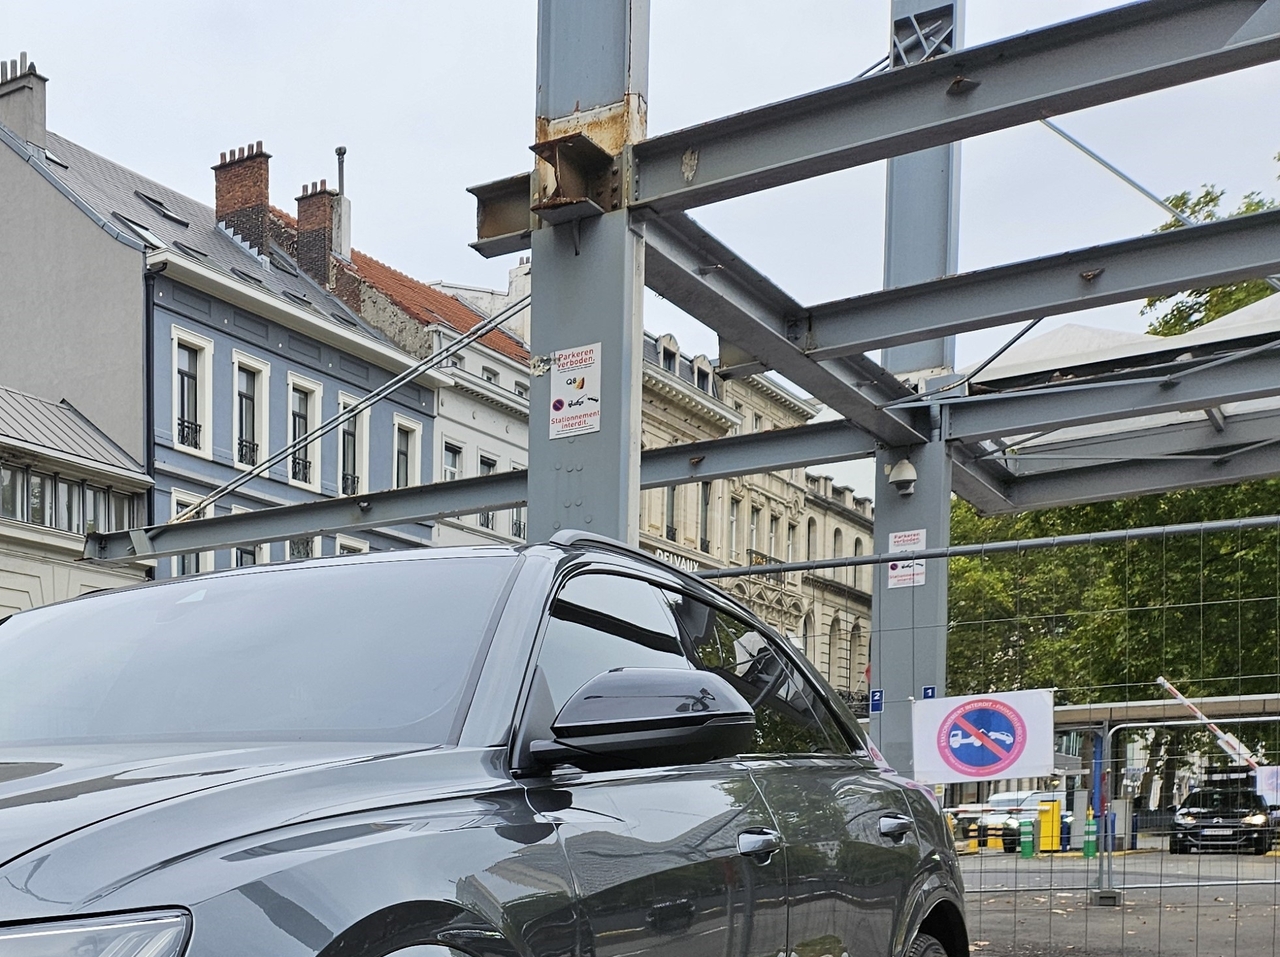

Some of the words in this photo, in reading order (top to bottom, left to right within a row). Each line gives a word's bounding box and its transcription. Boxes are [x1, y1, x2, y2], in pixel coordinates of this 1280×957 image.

[558, 349, 594, 360] Parkeren
[566, 377, 577, 385] Q8
[551, 410, 600, 424] Stationnement
[965, 701, 993, 710] INTERDIT
